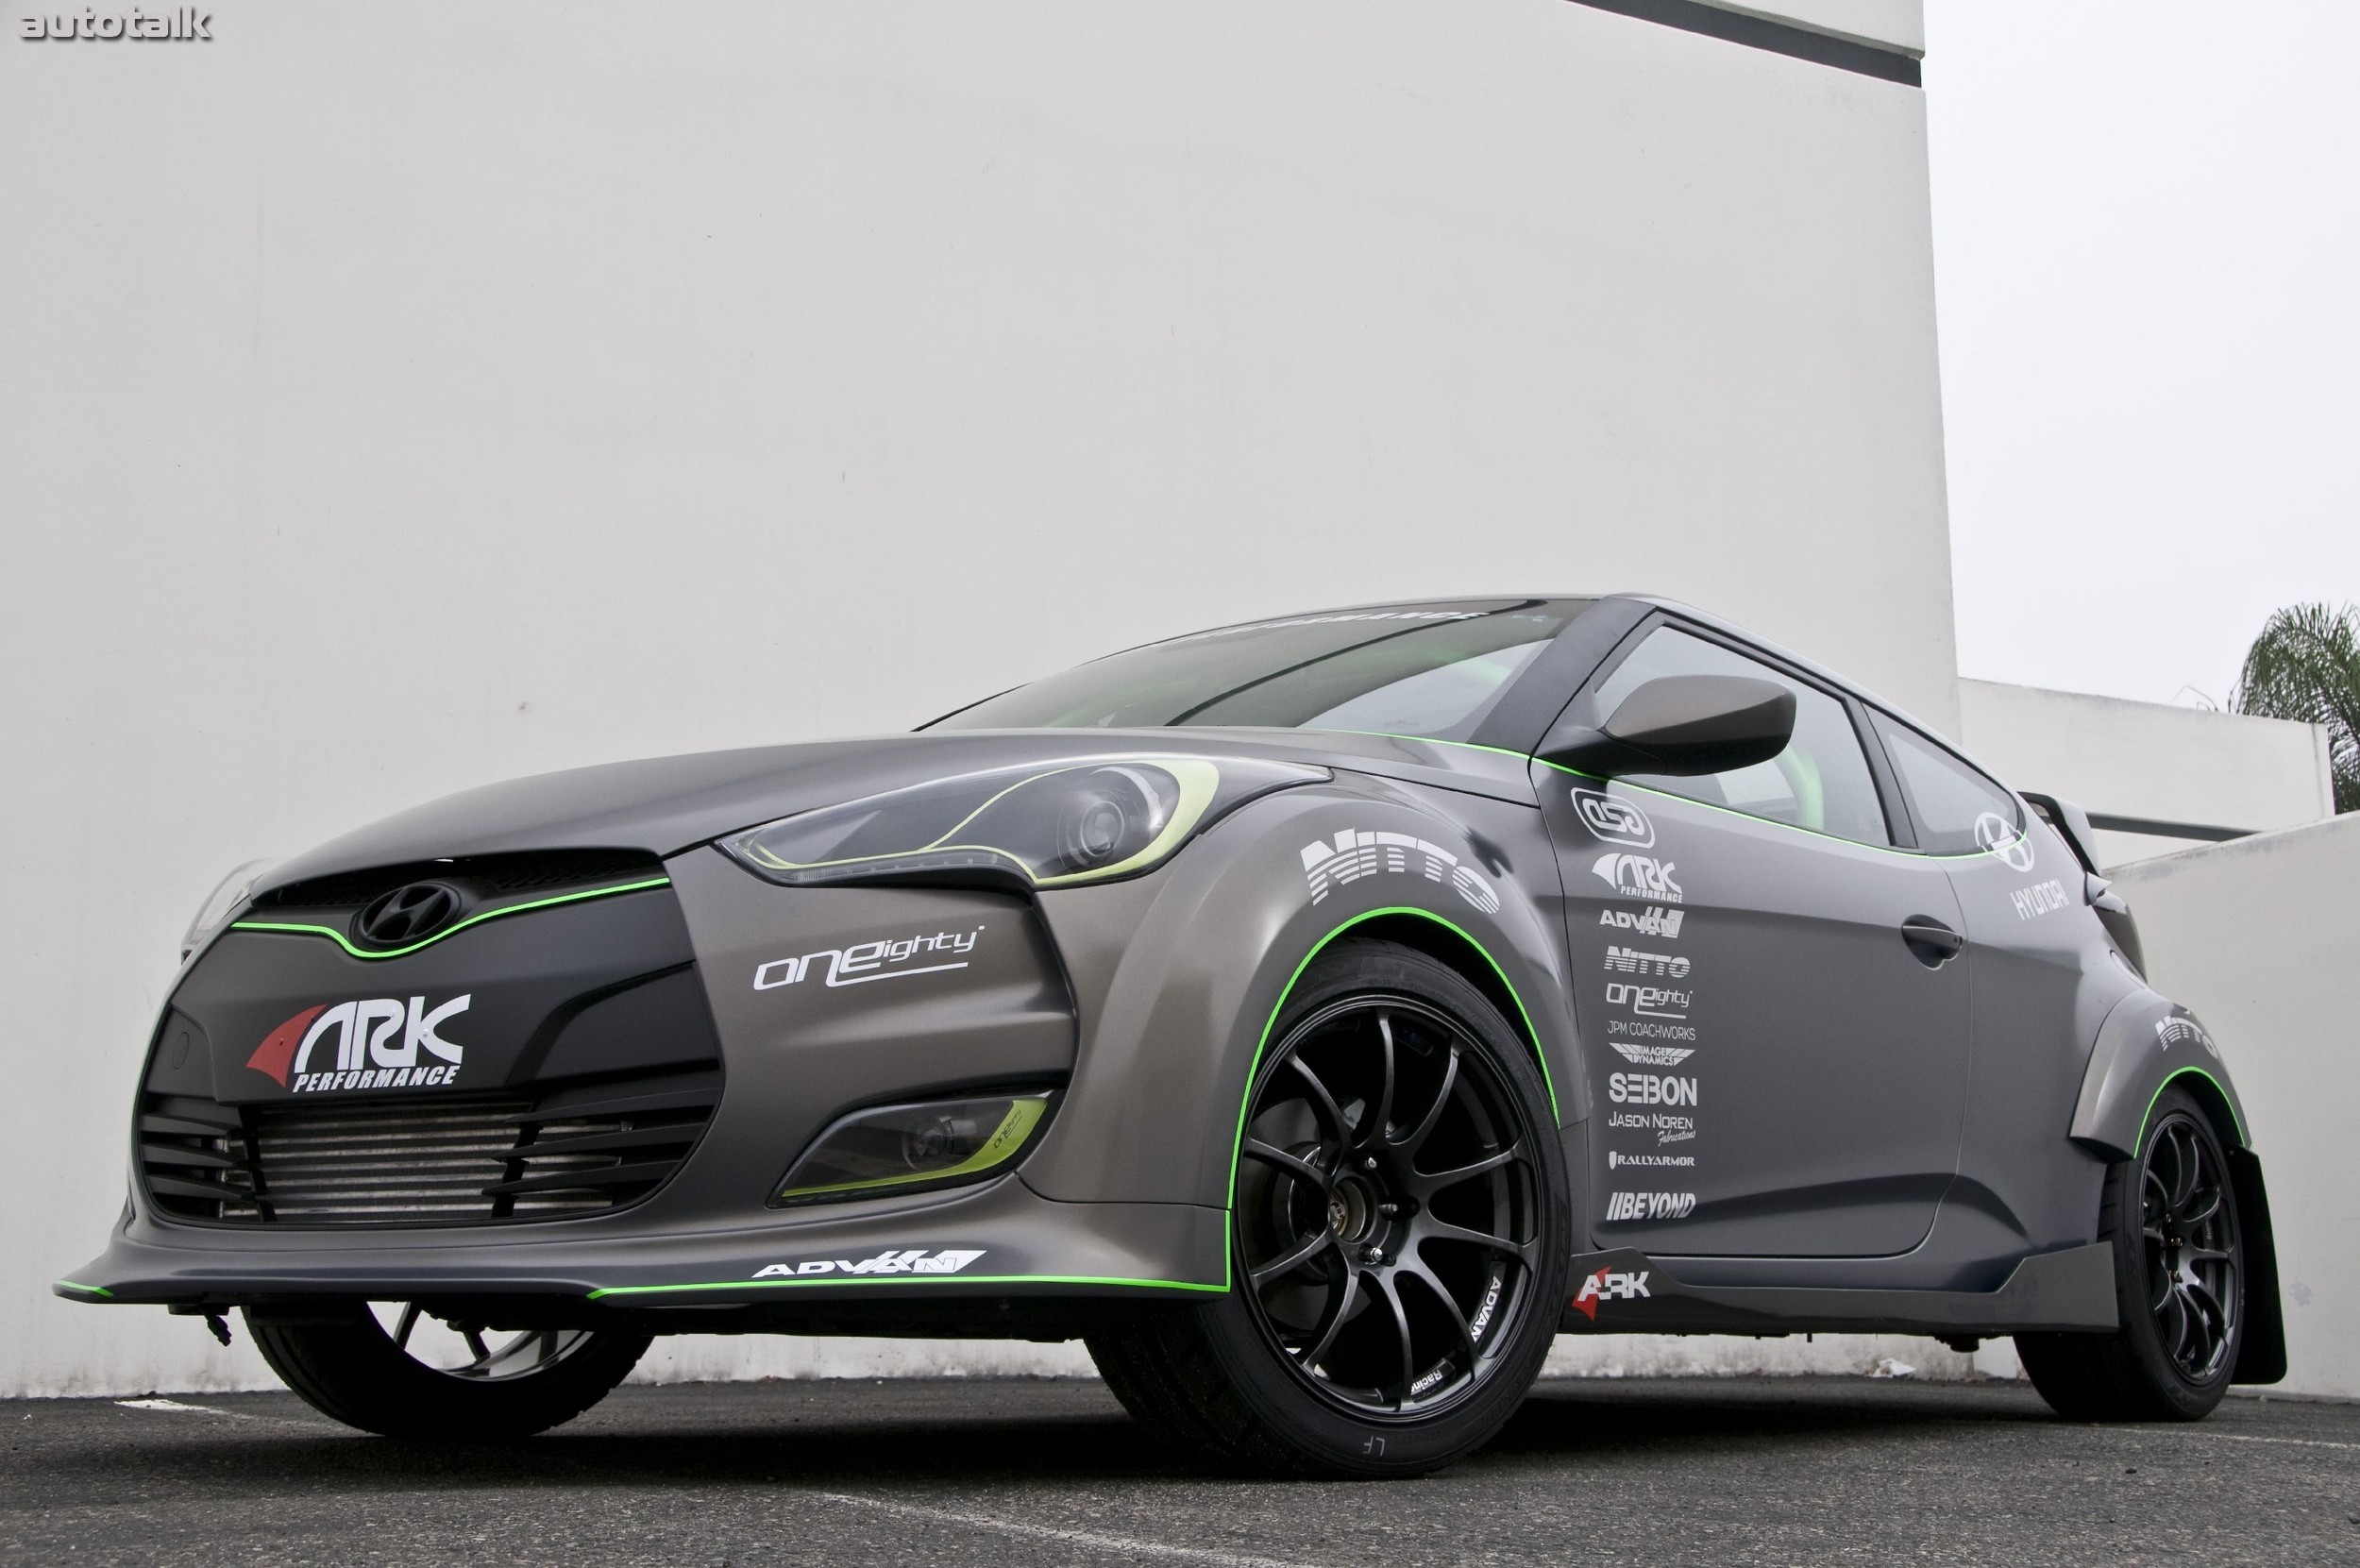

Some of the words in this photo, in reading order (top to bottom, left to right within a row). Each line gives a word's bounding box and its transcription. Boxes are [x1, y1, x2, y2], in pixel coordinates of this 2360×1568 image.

[1300, 827, 1500, 915] NITTO
[1616, 853, 1683, 894] ARK
[1620, 885, 1683, 903] PERFORMANCE
[2009, 878, 2070, 921] HYUNDAI
[1599, 905, 1685, 939] ADVAN
[1604, 945, 1691, 978] NITTO
[294, 993, 472, 1074] ARK
[1608, 1020, 1627, 1035] JPM
[1628, 1021, 1696, 1040] COACHWORKS
[2154, 1015, 2219, 1060] NITTO
[1632, 1054, 1675, 1067] DYNAMICS
[1642, 1045, 1667, 1056] IMAGE
[292, 1065, 462, 1093] PERFORMANCE
[1609, 1111, 1650, 1128] JASON
[1652, 1113, 1694, 1130] NOREN
[1657, 1129, 1696, 1147] Fabrications
[751, 1249, 988, 1279] ADVAN
[1576, 1271, 1651, 1302] ARK
[1470, 1275, 1502, 1343] ADVAN
[1363, 1435, 1385, 1457] LF
